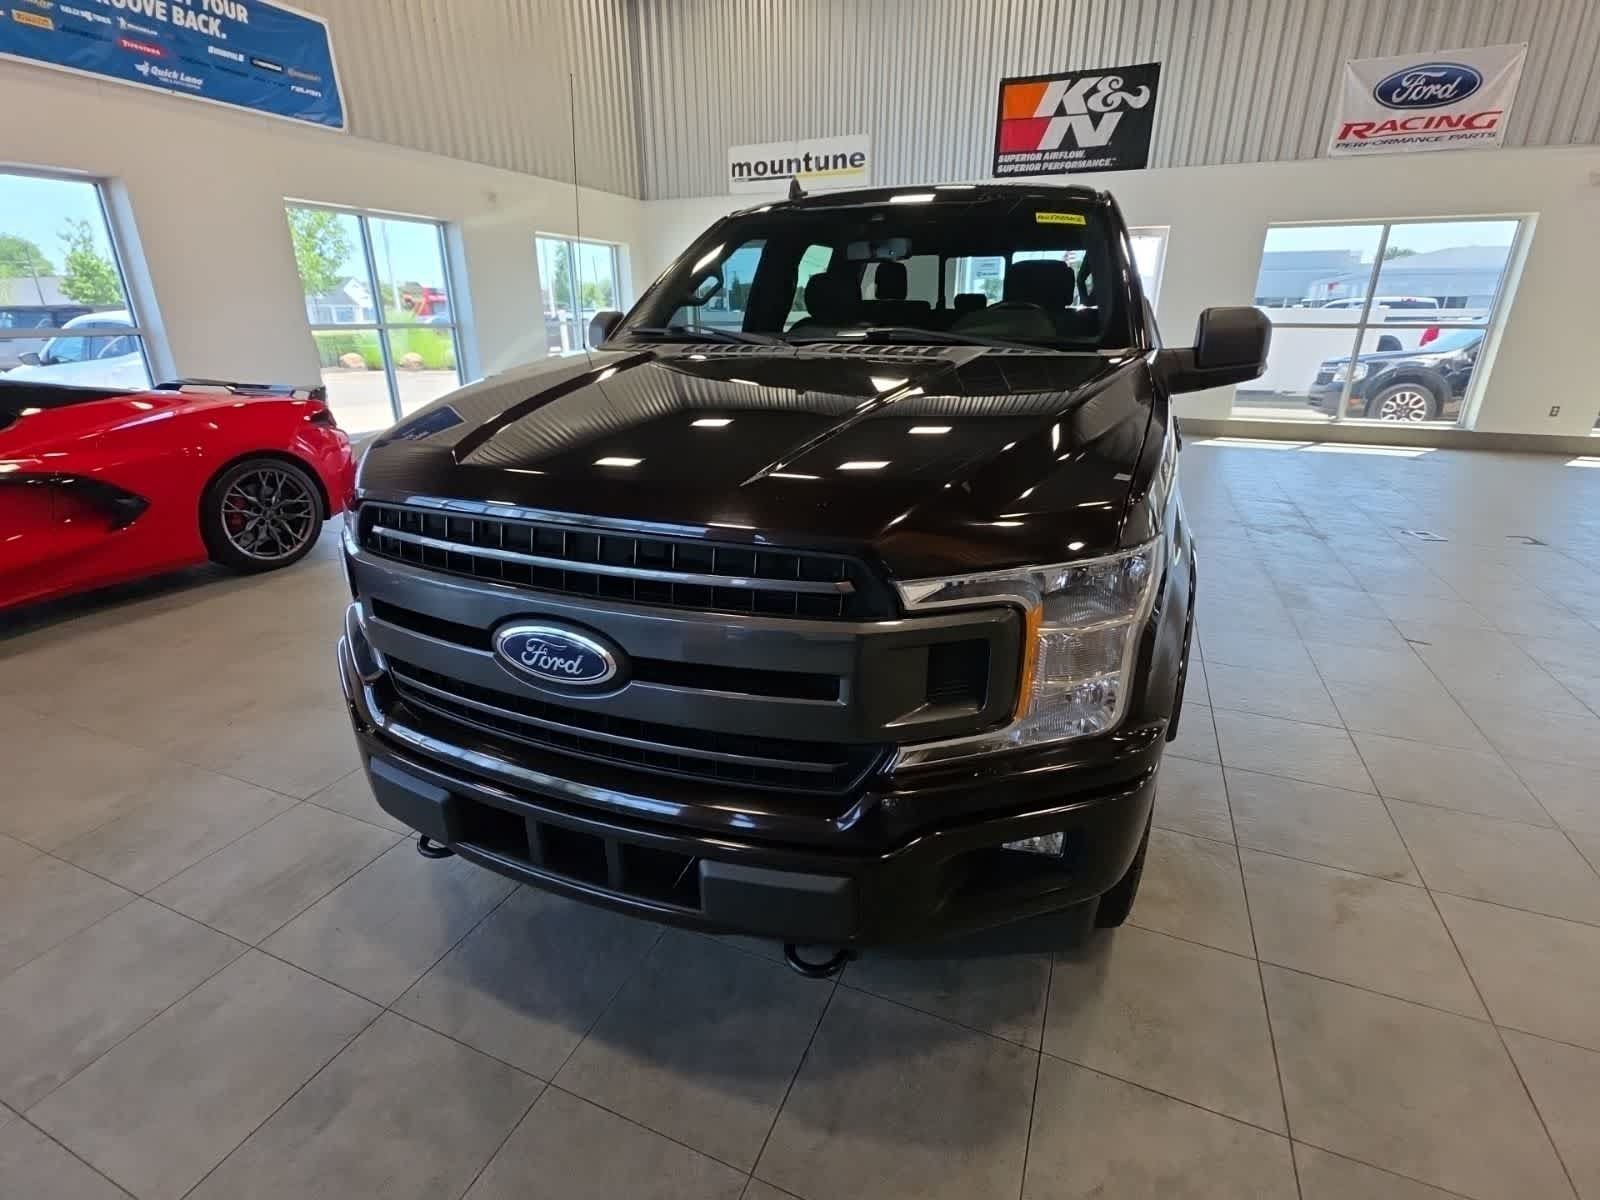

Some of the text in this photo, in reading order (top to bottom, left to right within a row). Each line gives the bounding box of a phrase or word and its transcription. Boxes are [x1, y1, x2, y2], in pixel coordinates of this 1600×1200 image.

[172, 5, 227, 39] BACK.
[200, 0, 248, 24] YOUR
[151, 65, 179, 80] Quick
[1391, 71, 1463, 103] Ford
[1338, 111, 1503, 140] RACING
[1336, 132, 1497, 149] PERFORMANCE PARTS
[731, 151, 866, 177] mountune
[997, 163, 1041, 173] SUPERIOR
[998, 152, 1042, 163] SUPERIOR
[520, 638, 584, 675] Ford
